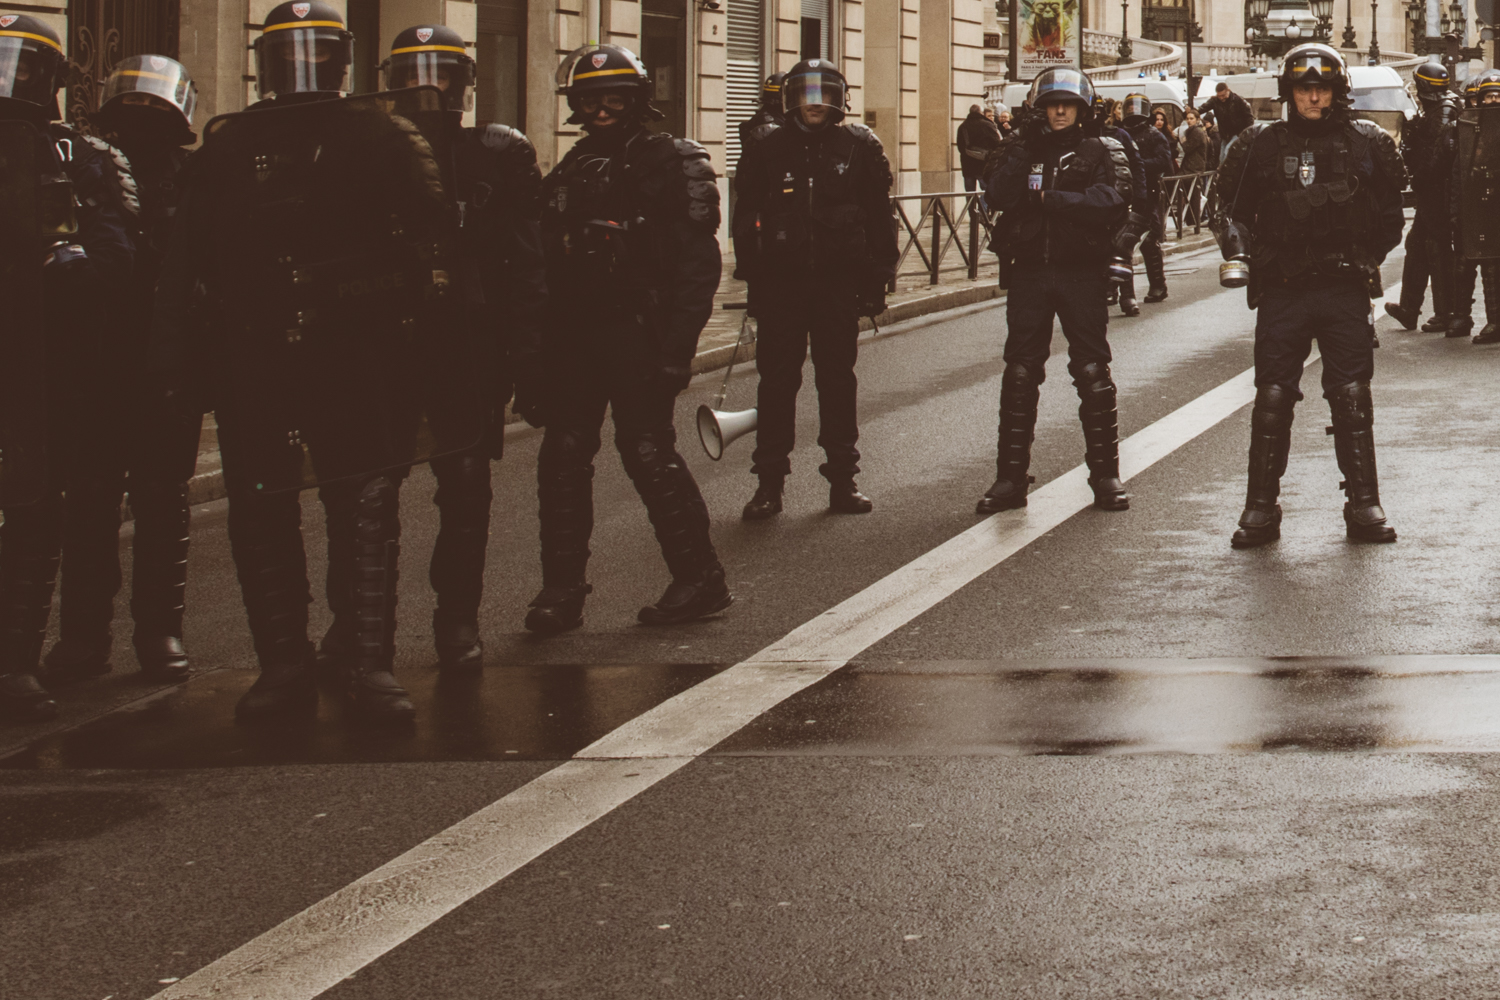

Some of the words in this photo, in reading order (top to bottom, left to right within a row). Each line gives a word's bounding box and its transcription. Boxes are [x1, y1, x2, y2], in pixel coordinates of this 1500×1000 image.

[712, 24, 718, 36] 2
[1036, 50, 1066, 60] FANS
[337, 271, 406, 299] POLICE
